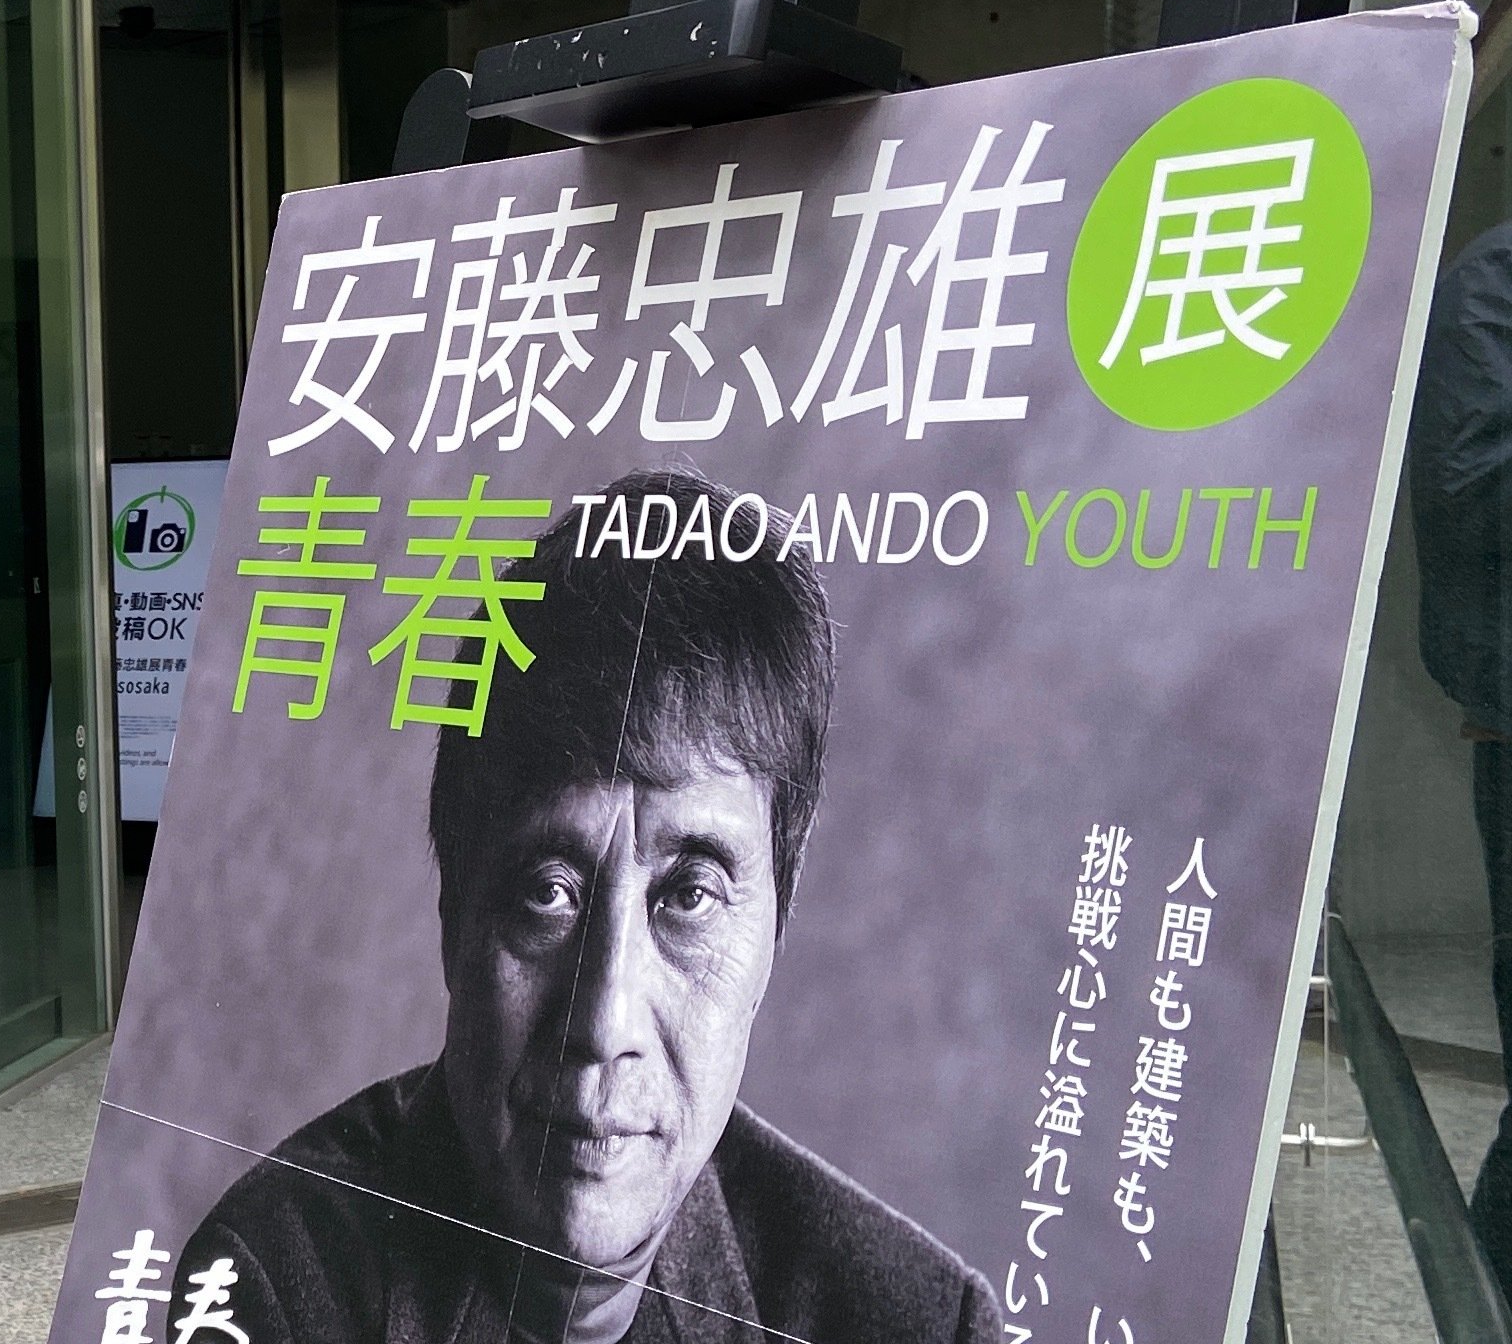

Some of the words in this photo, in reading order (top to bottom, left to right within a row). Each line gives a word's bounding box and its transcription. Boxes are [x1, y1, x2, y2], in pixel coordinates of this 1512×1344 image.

[266, 120, 1065, 457] 安藤忠雄
[1098, 137, 1315, 370] 展
[230, 474, 551, 738] 青春
[572, 492, 769, 562] TADAO
[785, 490, 989, 566] ANDO
[1014, 486, 1318, 570] YOUTH
